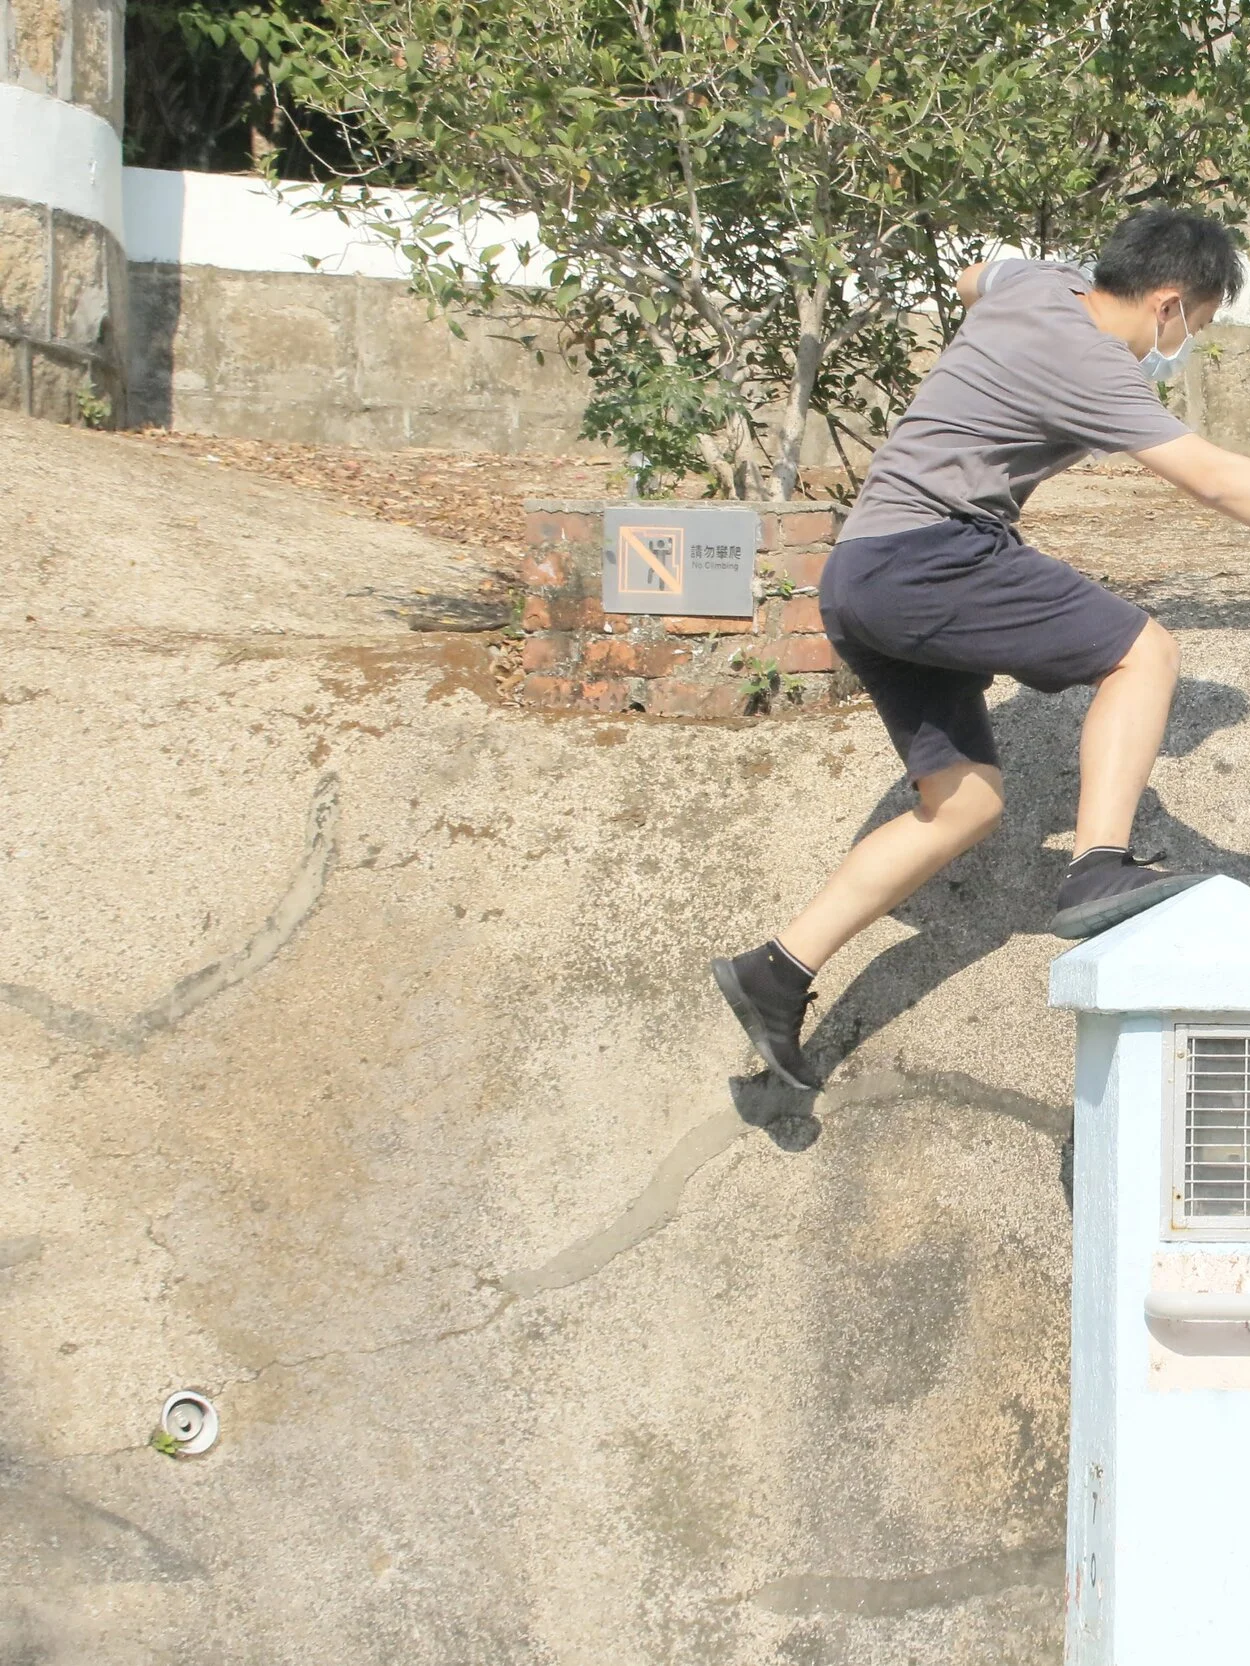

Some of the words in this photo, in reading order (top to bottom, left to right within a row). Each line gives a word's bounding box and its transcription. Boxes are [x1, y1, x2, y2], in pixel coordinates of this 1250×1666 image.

[690, 544, 741, 560] 請勿攀爬
[692, 561, 703, 569] No
[704, 561, 739, 572] Climbing
